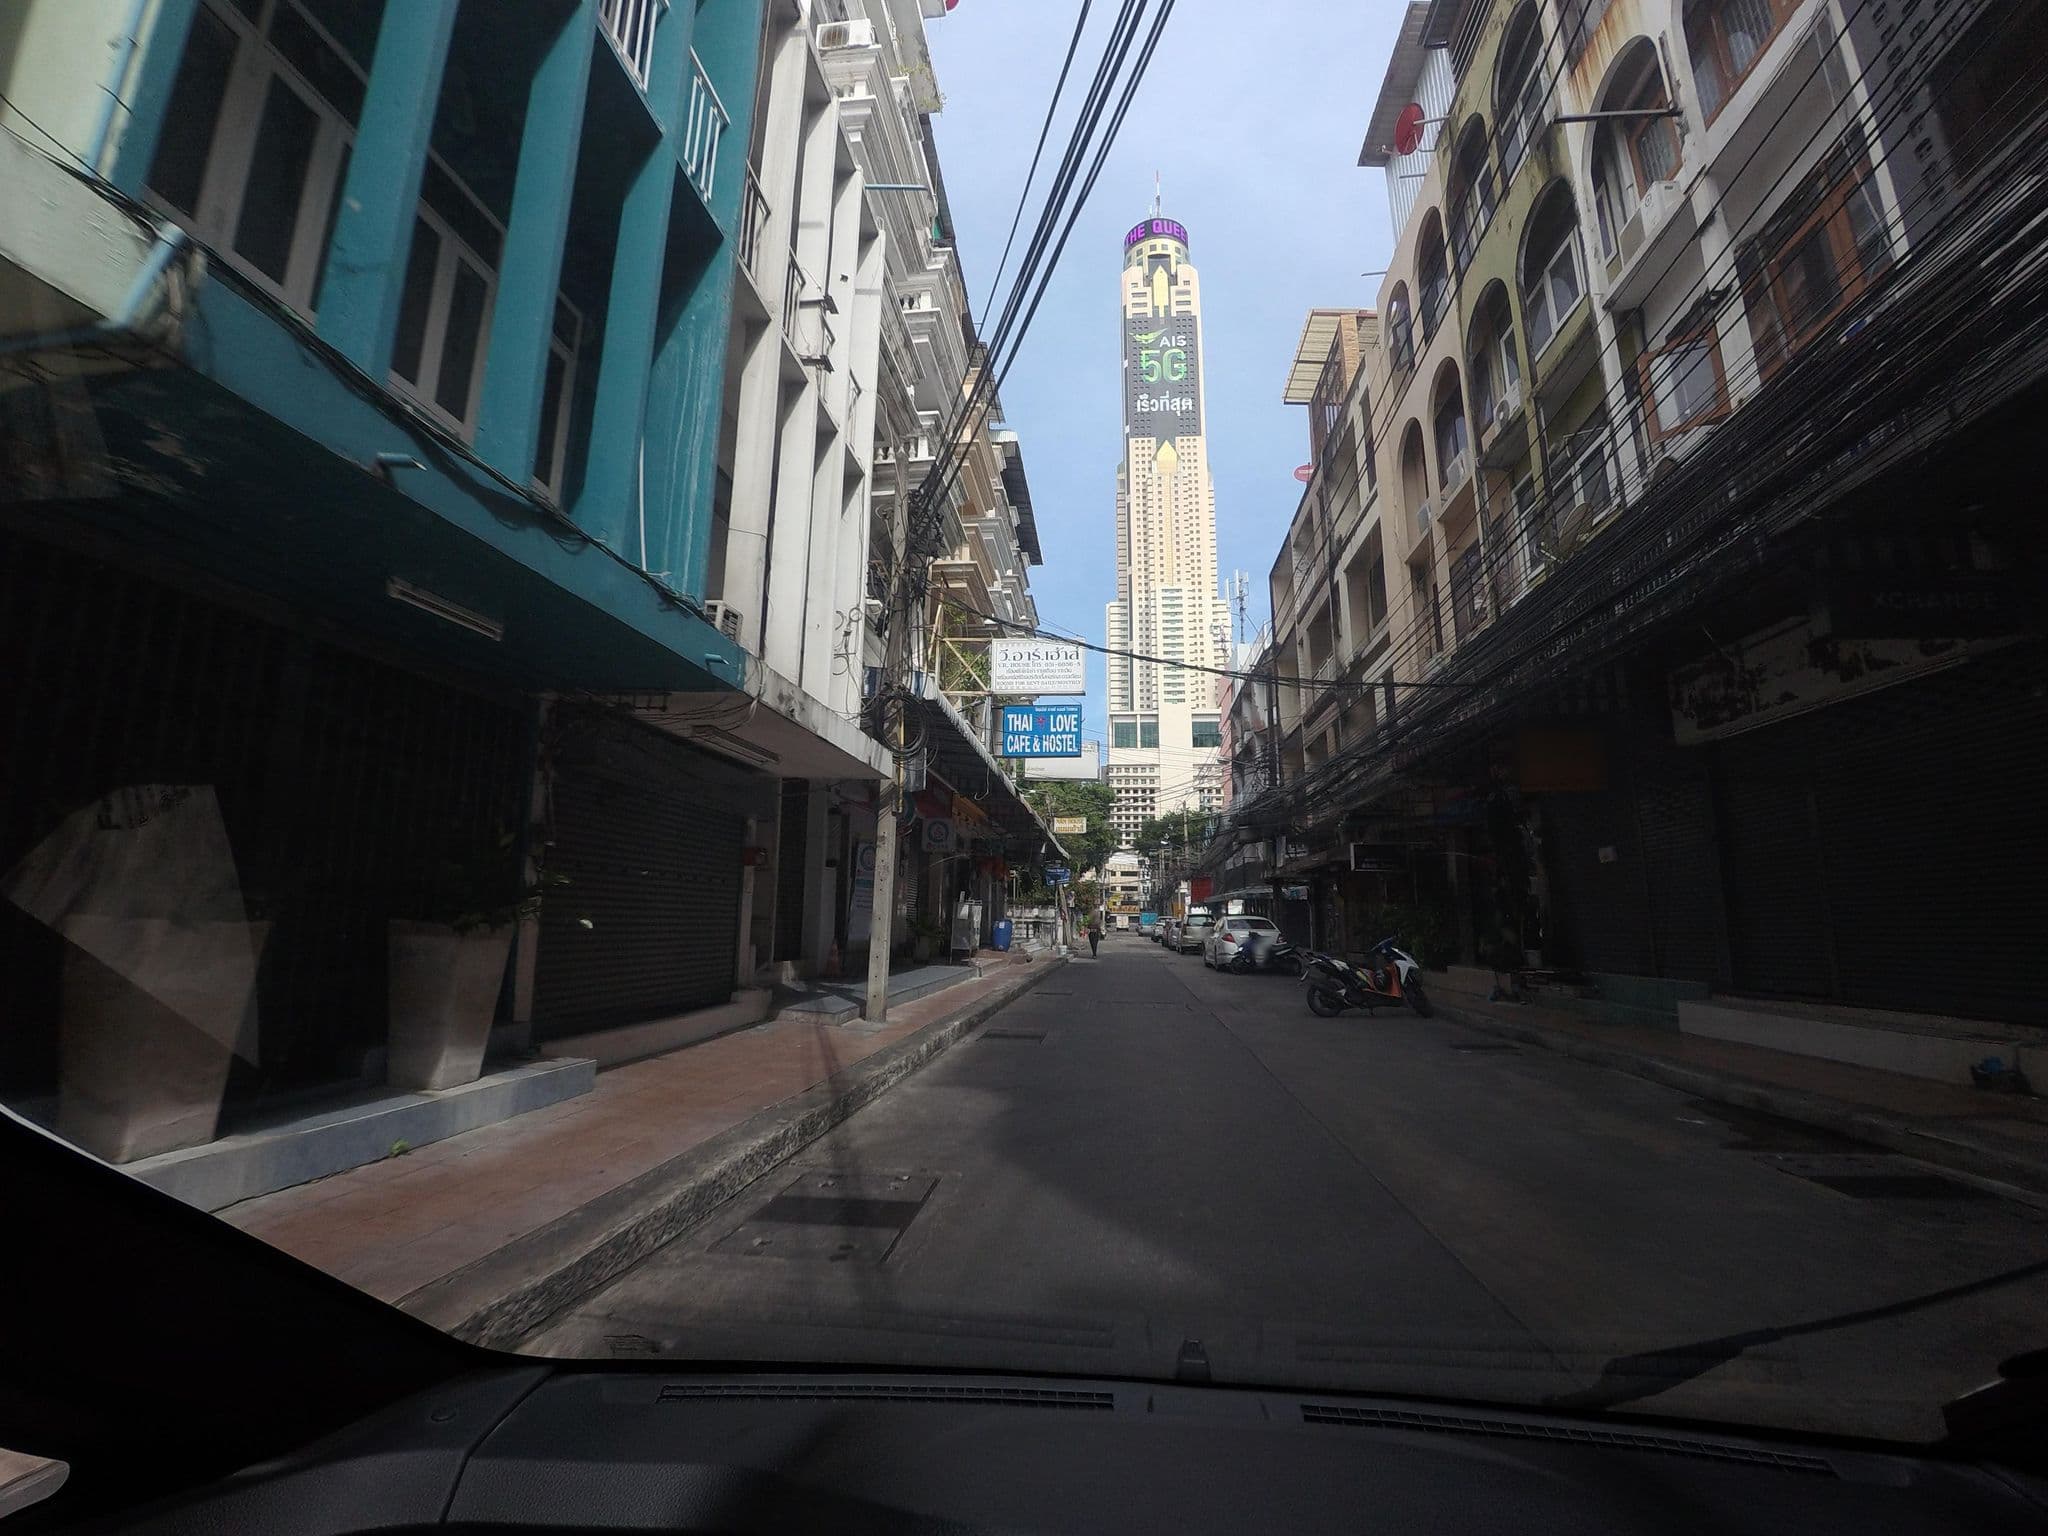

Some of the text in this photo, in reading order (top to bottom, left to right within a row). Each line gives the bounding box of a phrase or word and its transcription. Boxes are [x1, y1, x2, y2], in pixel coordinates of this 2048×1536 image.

[1159, 335, 1187, 348] AIS
[1140, 348, 1188, 383] 5G
[1136, 390, 1193, 417] เร็วที่สุด
[1007, 713, 1078, 732] THAI LOVE
[1007, 734, 1079, 753] CAFE & HOSTEL
